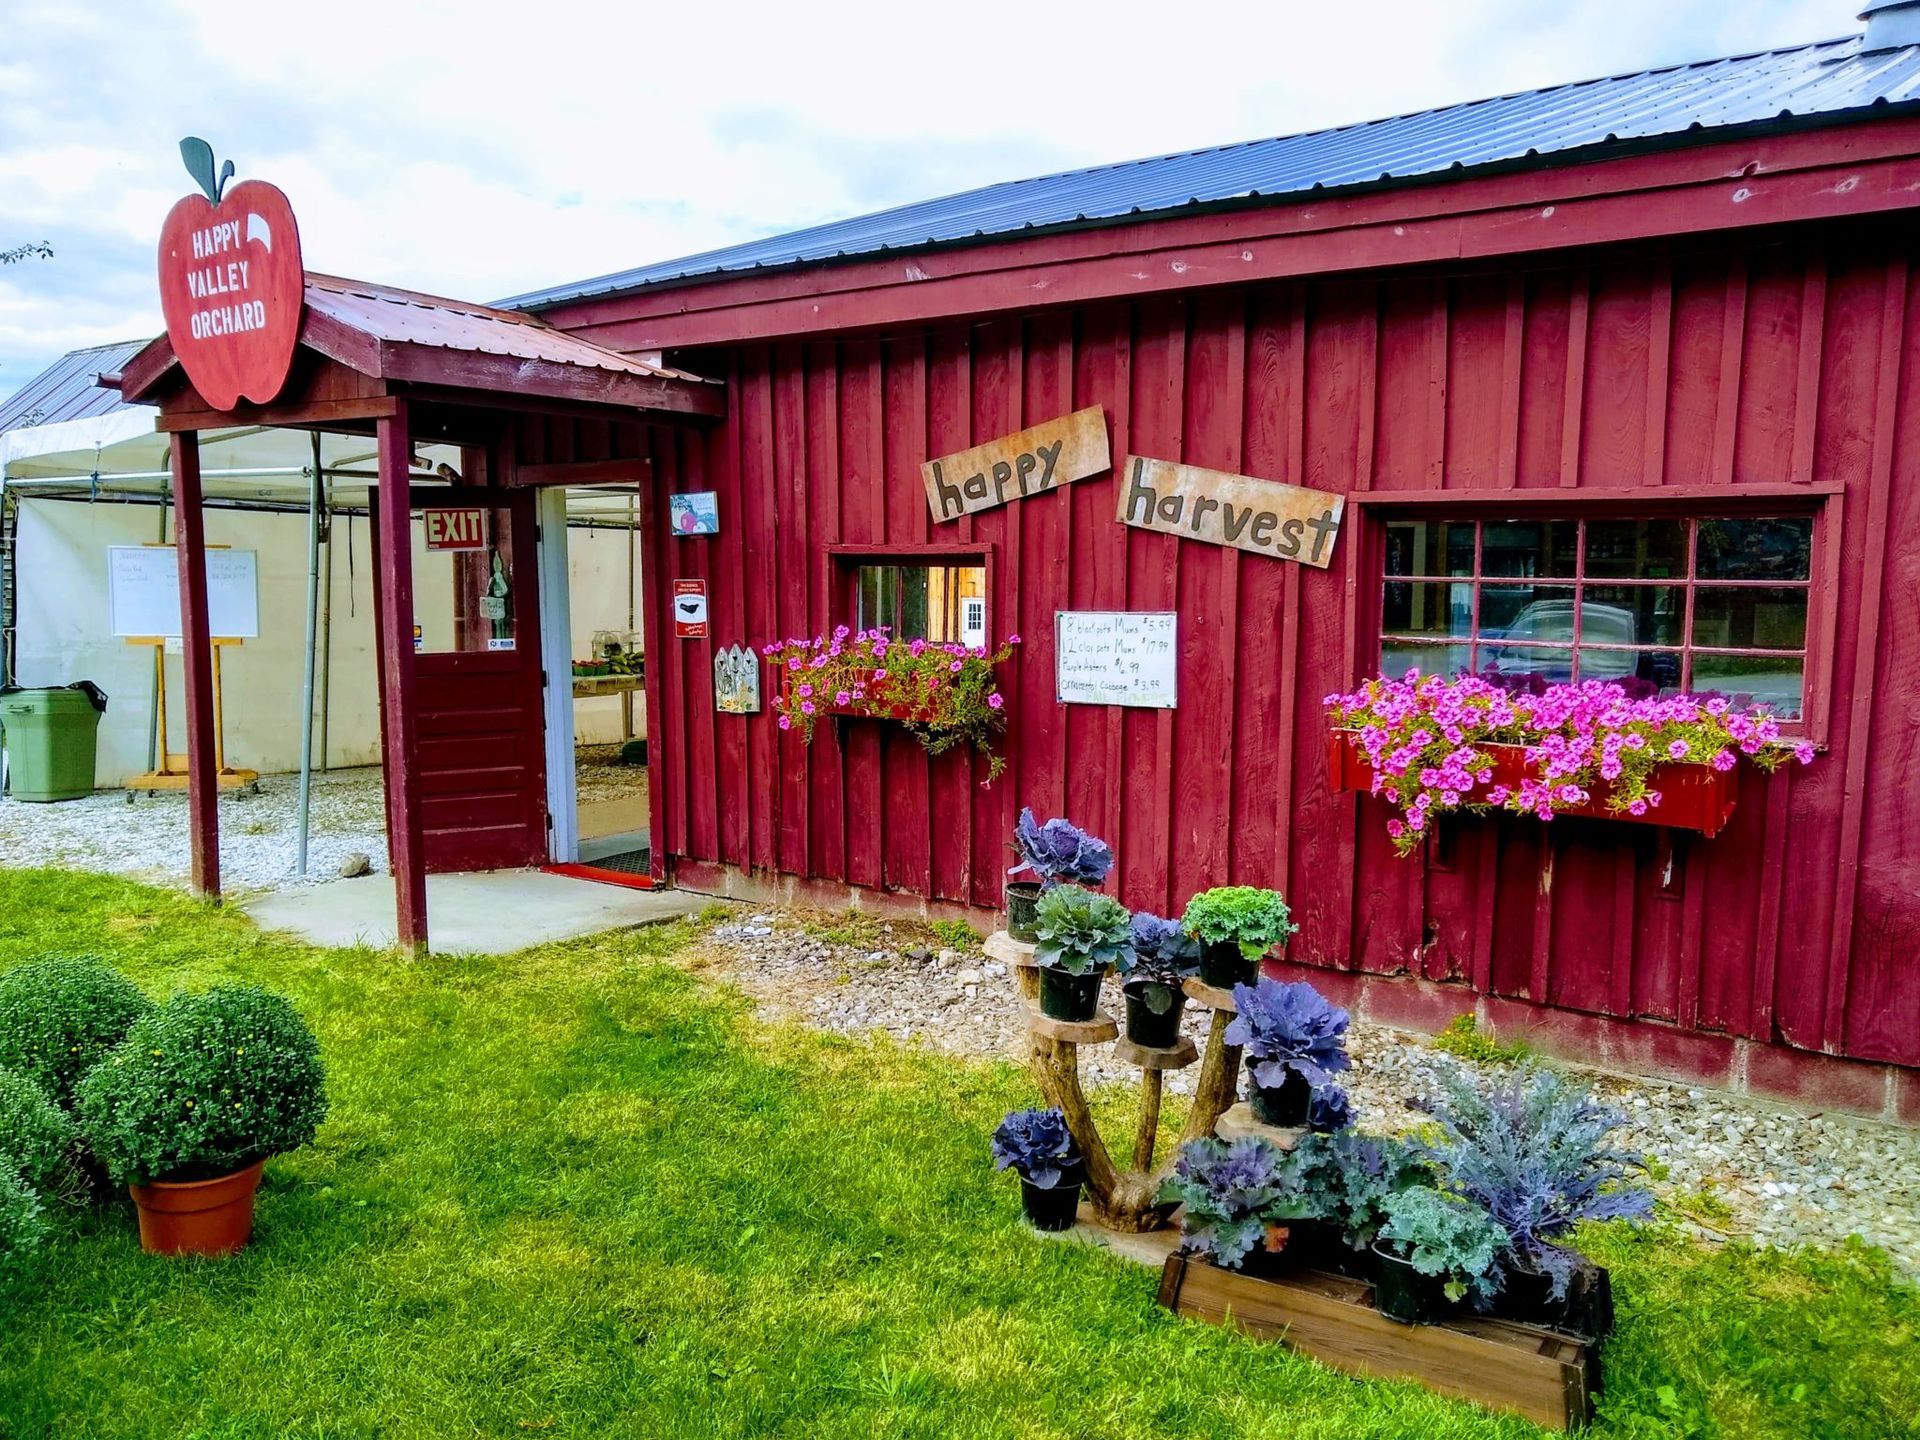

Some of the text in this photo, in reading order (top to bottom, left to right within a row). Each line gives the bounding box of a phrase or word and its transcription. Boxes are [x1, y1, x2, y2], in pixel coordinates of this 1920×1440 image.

[192, 219, 240, 260] HAPPY
[187, 260, 248, 299] VALLEY
[191, 300, 265, 340] ORCHARD
[932, 439, 1063, 518] happy
[427, 511, 480, 542] EXIT
[1126, 457, 1339, 563] harvest
[1115, 617, 1139, 634] Mums
[1114, 638, 1136, 654] Mums
[1114, 656, 1140, 675] $6.99
[1134, 678, 1160, 692] $3.99
